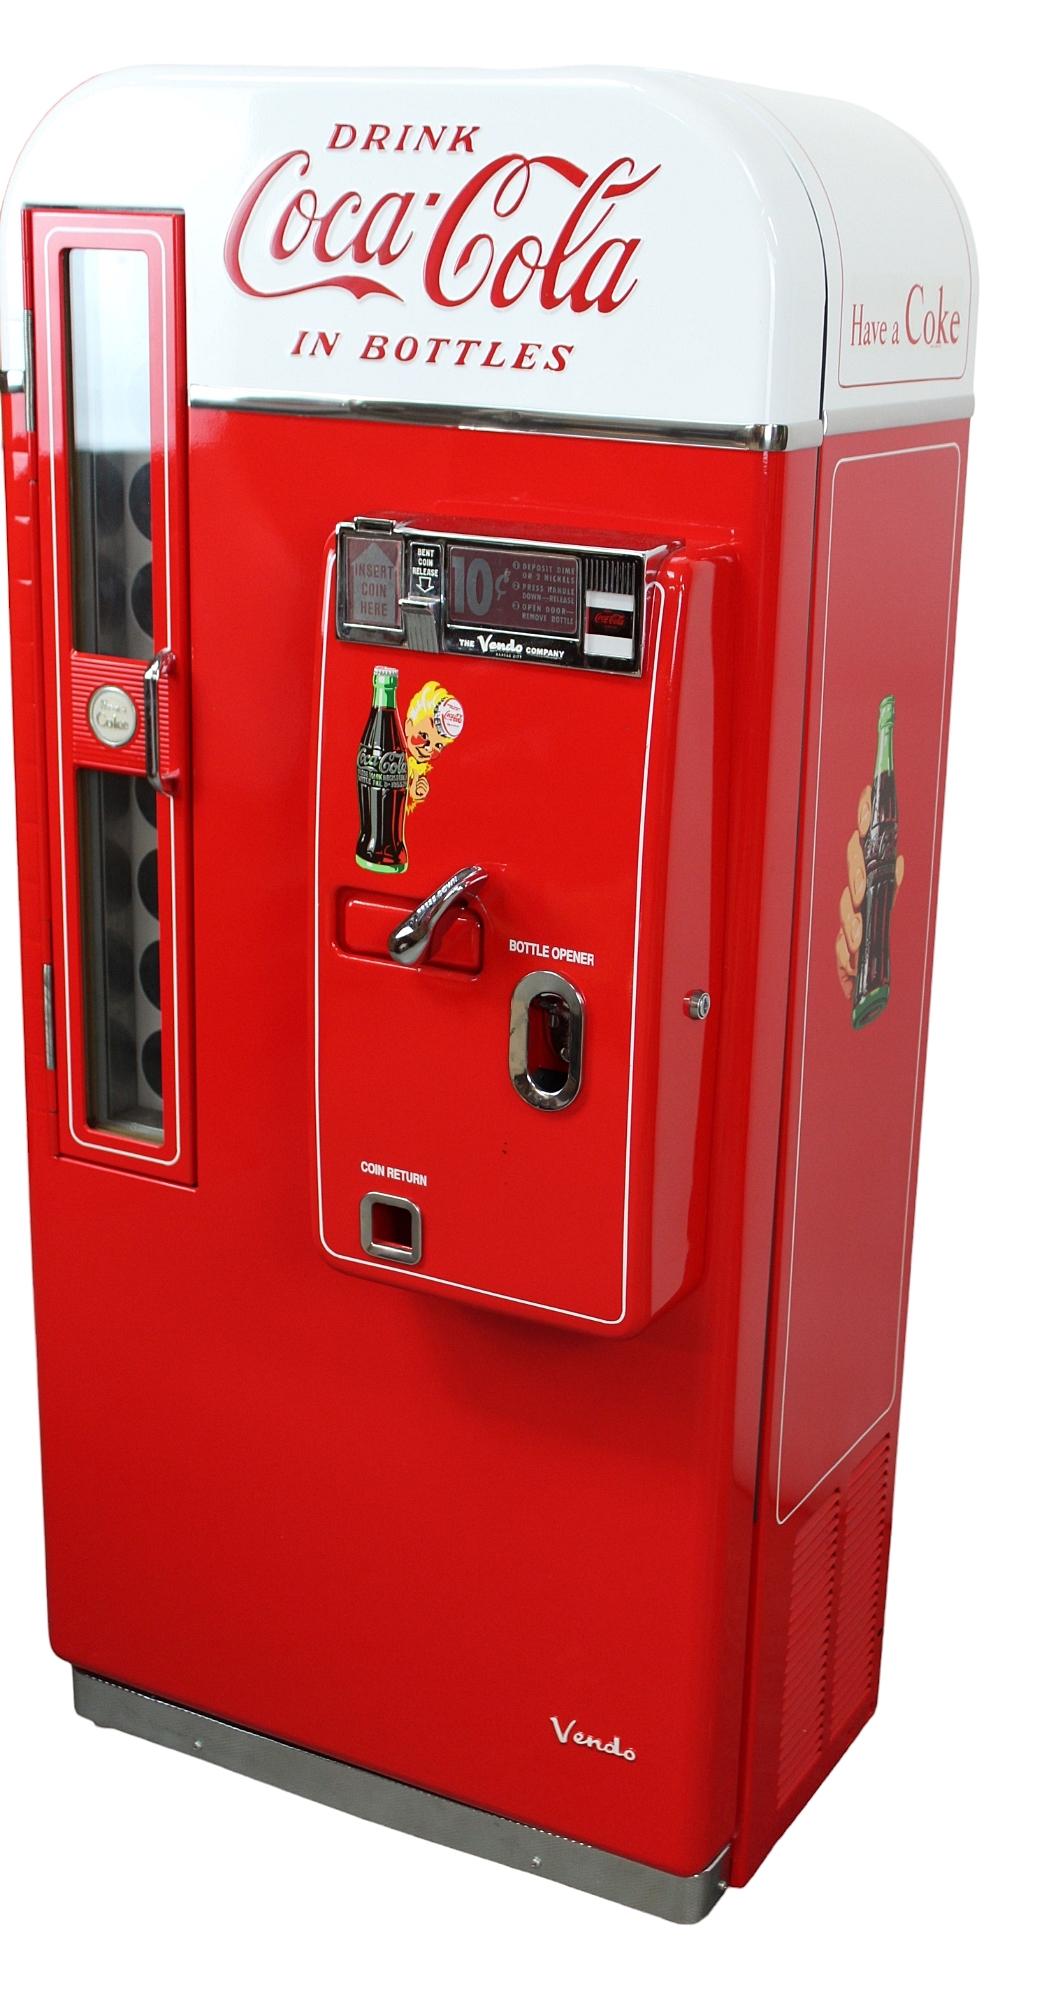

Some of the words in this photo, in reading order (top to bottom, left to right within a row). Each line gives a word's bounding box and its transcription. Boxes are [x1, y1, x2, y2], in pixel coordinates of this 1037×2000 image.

[327, 123, 481, 153] DRINK
[850, 303, 887, 346] Have
[892, 321, 900, 345] a
[905, 283, 960, 345] Coke
[291, 331, 340, 357] IN
[360, 335, 574, 372] BOTTLES
[417, 548, 435, 557] BENT
[417, 558, 434, 567] COIN
[522, 562, 553, 573] DEPOSIT
[556, 566, 575, 575] DIME
[355, 563, 394, 579] INSERT
[412, 567, 439, 577] RELEASE
[544, 574, 575, 584] NICKELS
[361, 583, 387, 597] COIN
[522, 583, 544, 592] PRESS
[547, 586, 575, 596] HANDLE
[360, 601, 388, 617] HERE
[522, 603, 542, 613] OPEN
[522, 612, 547, 622] REMOVE
[551, 616, 574, 625] BOTTLE
[459, 638, 475, 648] THE
[477, 634, 523, 653] Vendo
[525, 646, 565, 658] COMPANY
[96, 711, 129, 729] Coke
[509, 939, 550, 958] BOTTLE
[551, 946, 595, 967] OPENER
[360, 1161, 385, 1177] COIN
[386, 1167, 427, 1187] RETURN
[550, 1716, 636, 1761] Vendo
